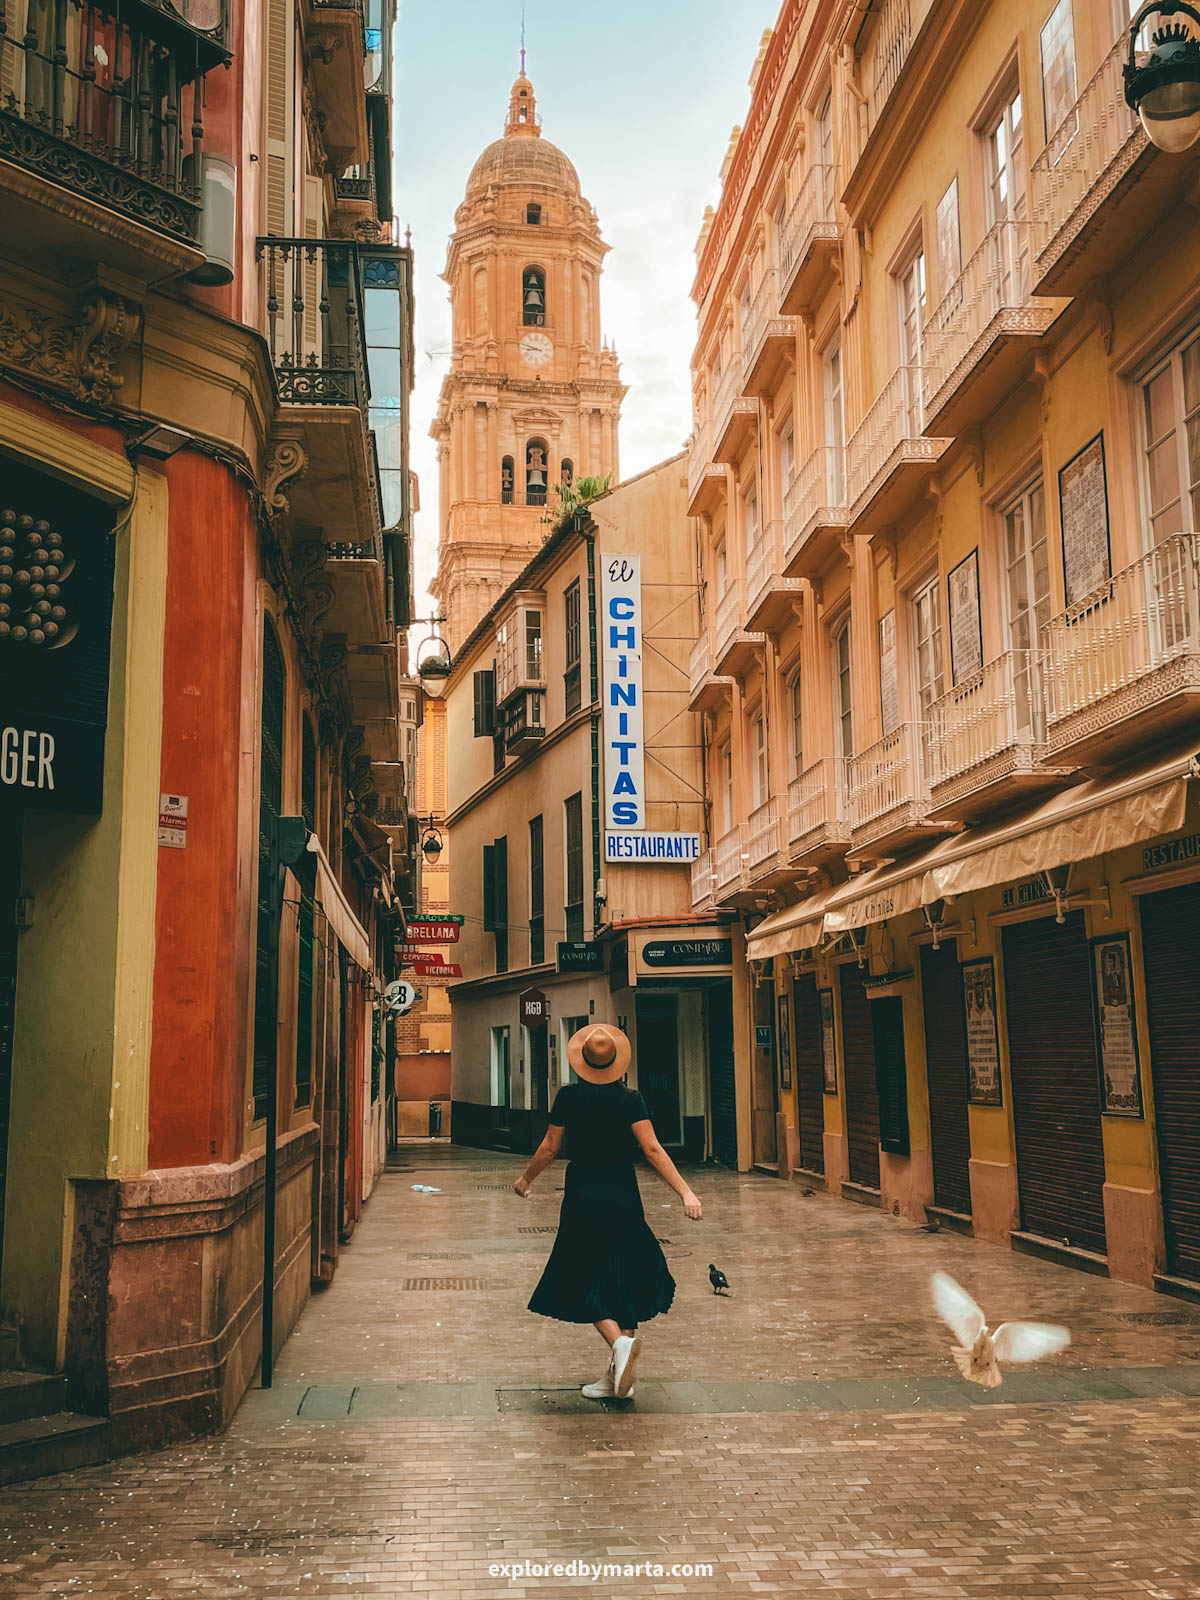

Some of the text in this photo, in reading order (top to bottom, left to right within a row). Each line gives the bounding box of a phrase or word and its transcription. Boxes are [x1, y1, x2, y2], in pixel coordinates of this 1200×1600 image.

[609, 559, 634, 582] El
[608, 597, 639, 826] CHINITAS
[607, 836, 699, 859] RESTAURANTE
[406, 925, 455, 939] ORELLANA
[402, 953, 435, 961] CERVEZA
[425, 965, 455, 976] VICTORIA
[525, 1001, 542, 1015] KGB
